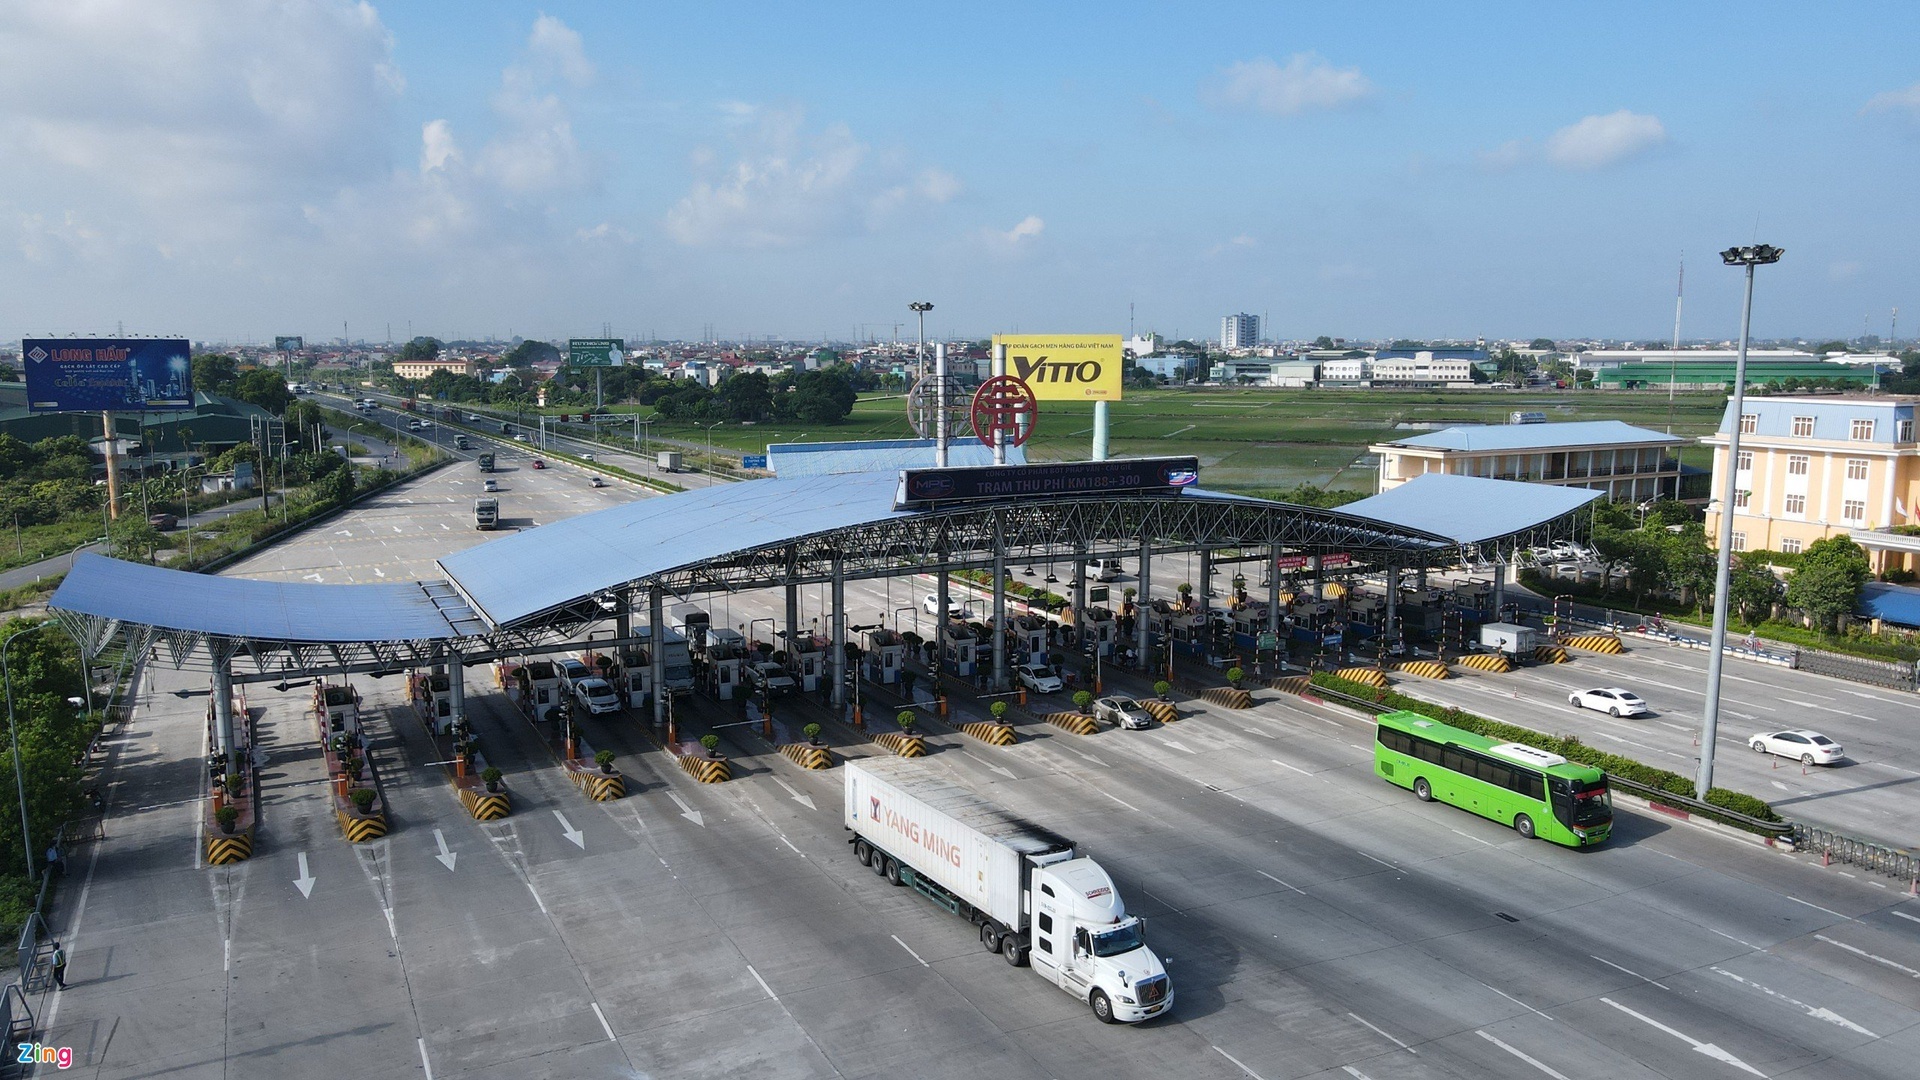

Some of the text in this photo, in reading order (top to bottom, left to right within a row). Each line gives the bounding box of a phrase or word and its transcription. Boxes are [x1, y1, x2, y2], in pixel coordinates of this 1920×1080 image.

[51, 349, 92, 361] LONG
[915, 479, 951, 488] MPC
[977, 475, 1140, 494] TRẠM THU PHÍ KM188+300
[884, 805, 919, 844] YANG
[923, 828, 961, 868] MING
